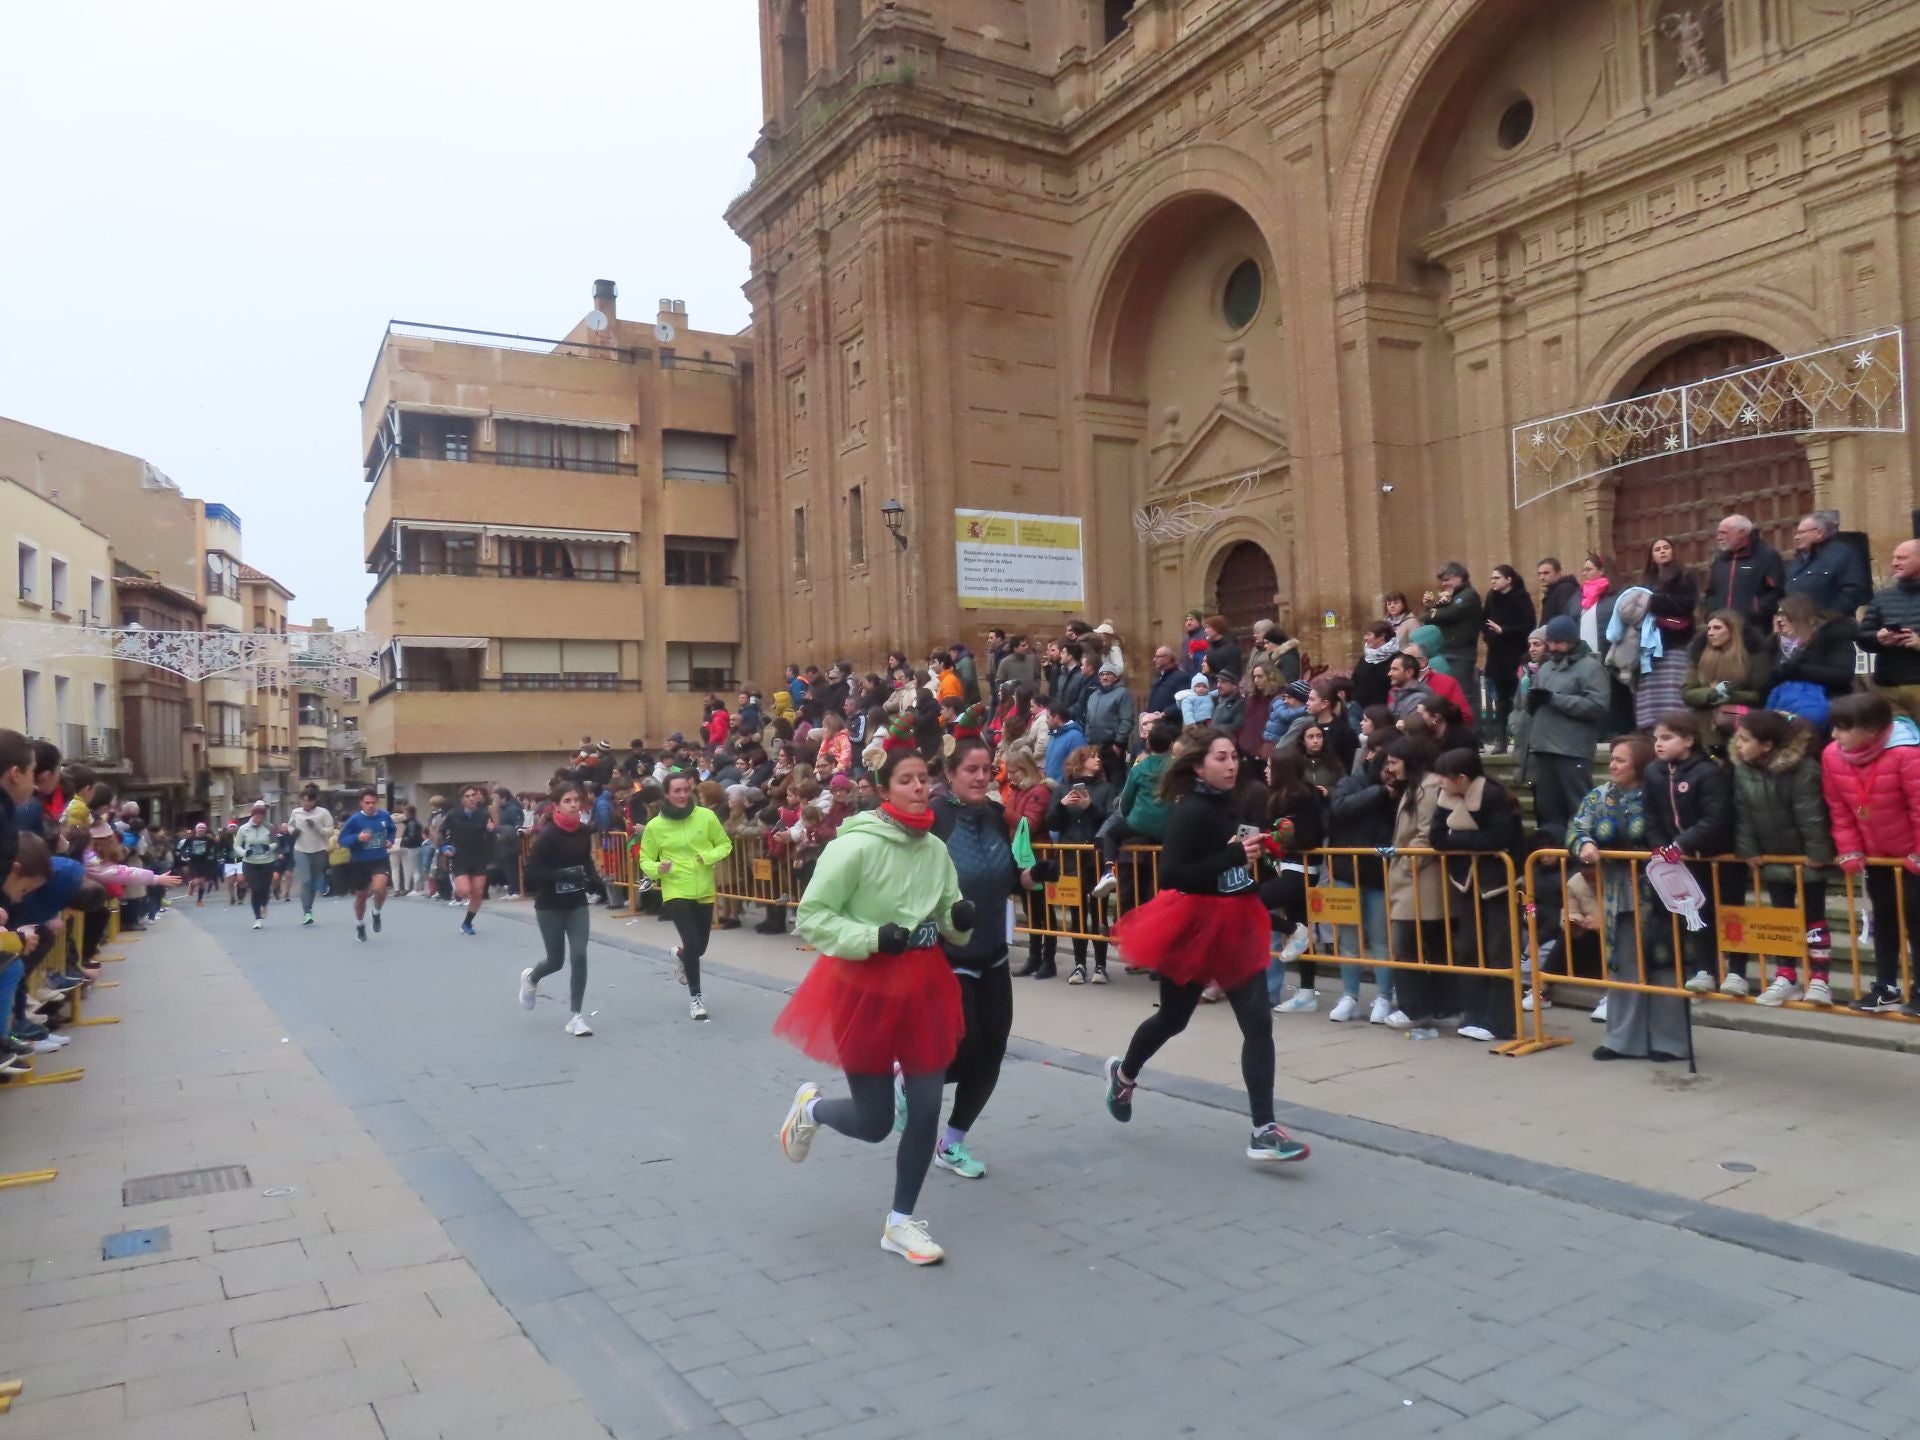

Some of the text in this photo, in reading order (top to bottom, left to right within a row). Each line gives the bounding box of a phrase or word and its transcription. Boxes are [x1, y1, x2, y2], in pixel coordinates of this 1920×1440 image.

[1750, 923, 1799, 933] AYUNTAMIENTO
[1757, 933, 1793, 942] DE ALFARO
